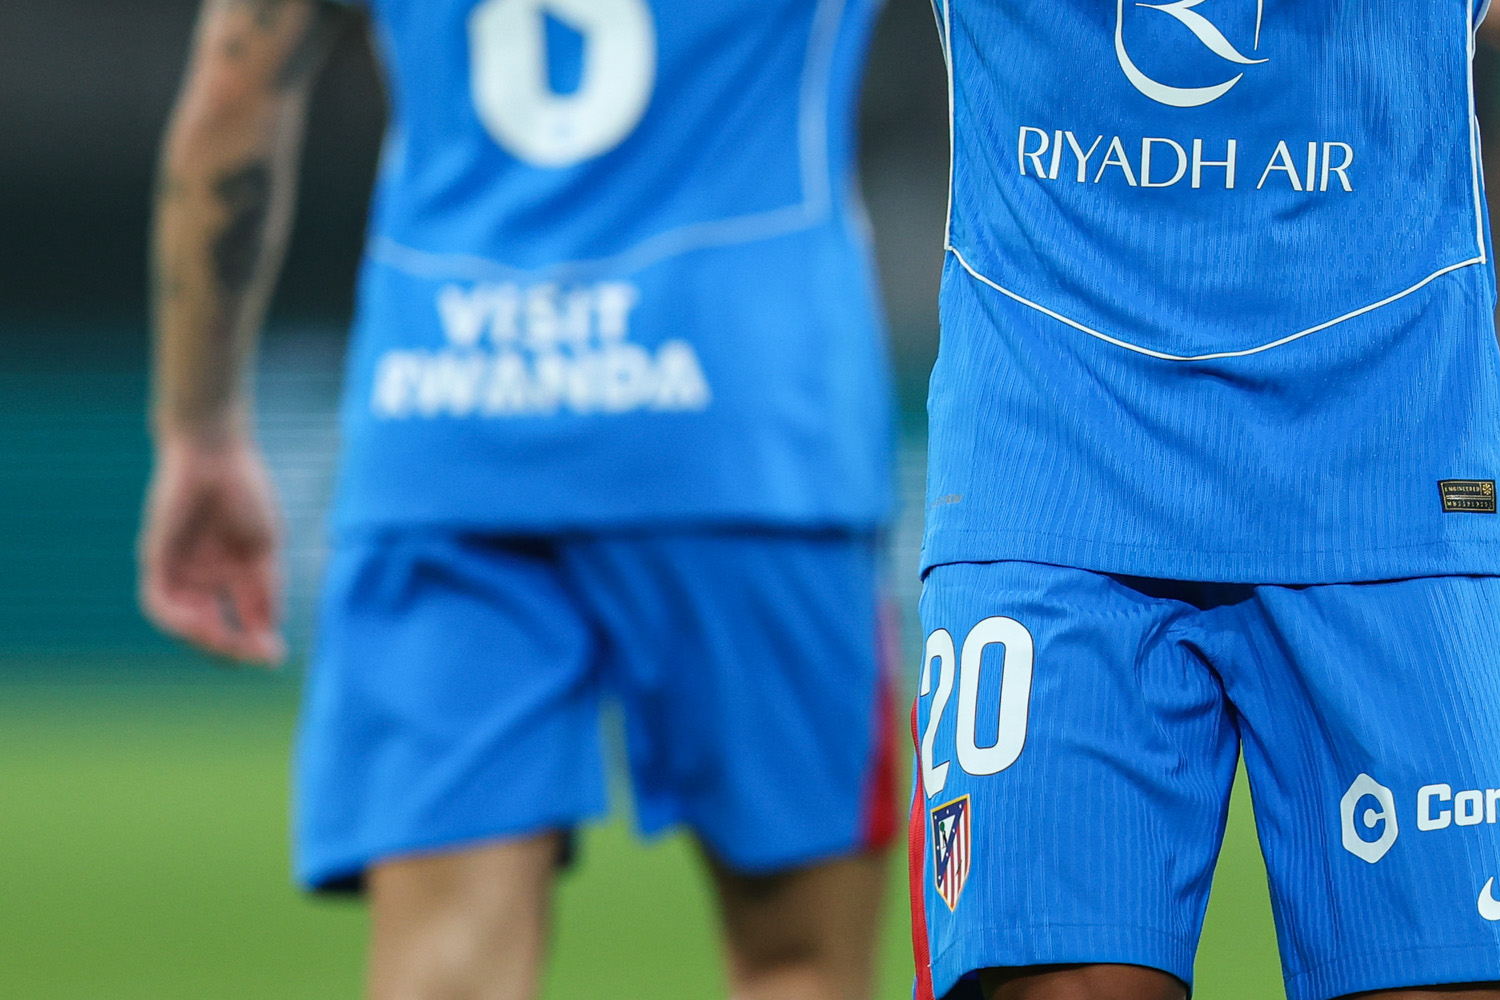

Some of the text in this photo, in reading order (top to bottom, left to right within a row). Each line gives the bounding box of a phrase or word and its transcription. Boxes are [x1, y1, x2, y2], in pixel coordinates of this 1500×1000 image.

[1017, 125, 1354, 192] RIYADH AIR
[436, 280, 641, 350] VISIT
[370, 339, 712, 419] RWANDA
[919, 615, 1035, 801] 20
